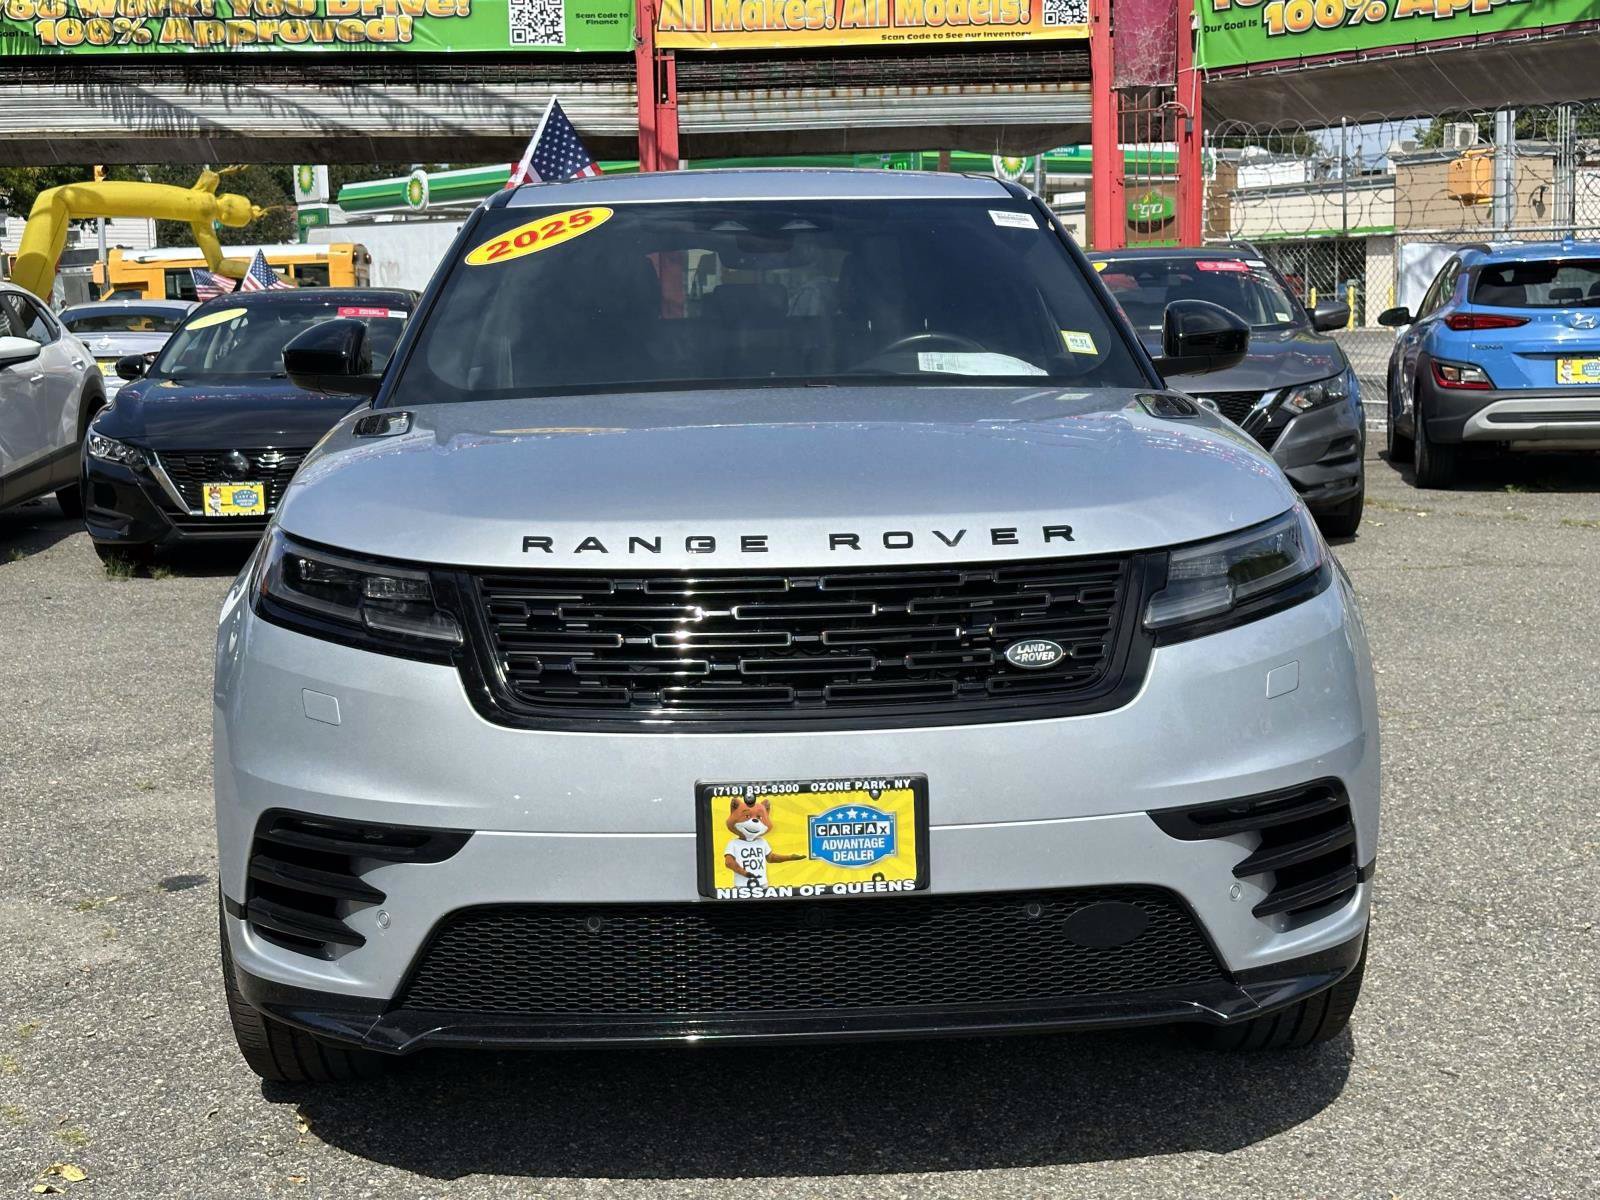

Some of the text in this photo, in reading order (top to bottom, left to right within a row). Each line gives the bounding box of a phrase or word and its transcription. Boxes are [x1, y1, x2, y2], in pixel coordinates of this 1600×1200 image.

[0, 0, 470, 20] ou Work! You Drive!
[657, 0, 1031, 31] All Makes! All Models!
[1203, 24, 1222, 33] Our
[1224, 20, 1246, 31] Goal
[1248, 19, 1258, 27] Is
[1263, 0, 1387, 36] 100%
[35, 17, 153, 45] 100%
[159, 14, 413, 48] Approved!
[881, 33, 905, 41] Scan
[907, 32, 931, 40] Code
[945, 31, 963, 39] See
[485, 210, 596, 262] 2025
[522, 524, 1076, 554] RANGE ROVER
[1016, 643, 1046, 654] LAND
[1020, 651, 1056, 662] ROVER
[713, 779, 911, 796] (718) 835-8300 OZONE PARK, NY
[816, 822, 890, 837] CARFAX
[822, 837, 886, 851] ADVANTAGE
[740, 847, 764, 858] CAR
[833, 850, 875, 862] DEALER
[742, 858, 765, 871] FOX
[716, 879, 916, 900] NISSAN OF QUEENS
